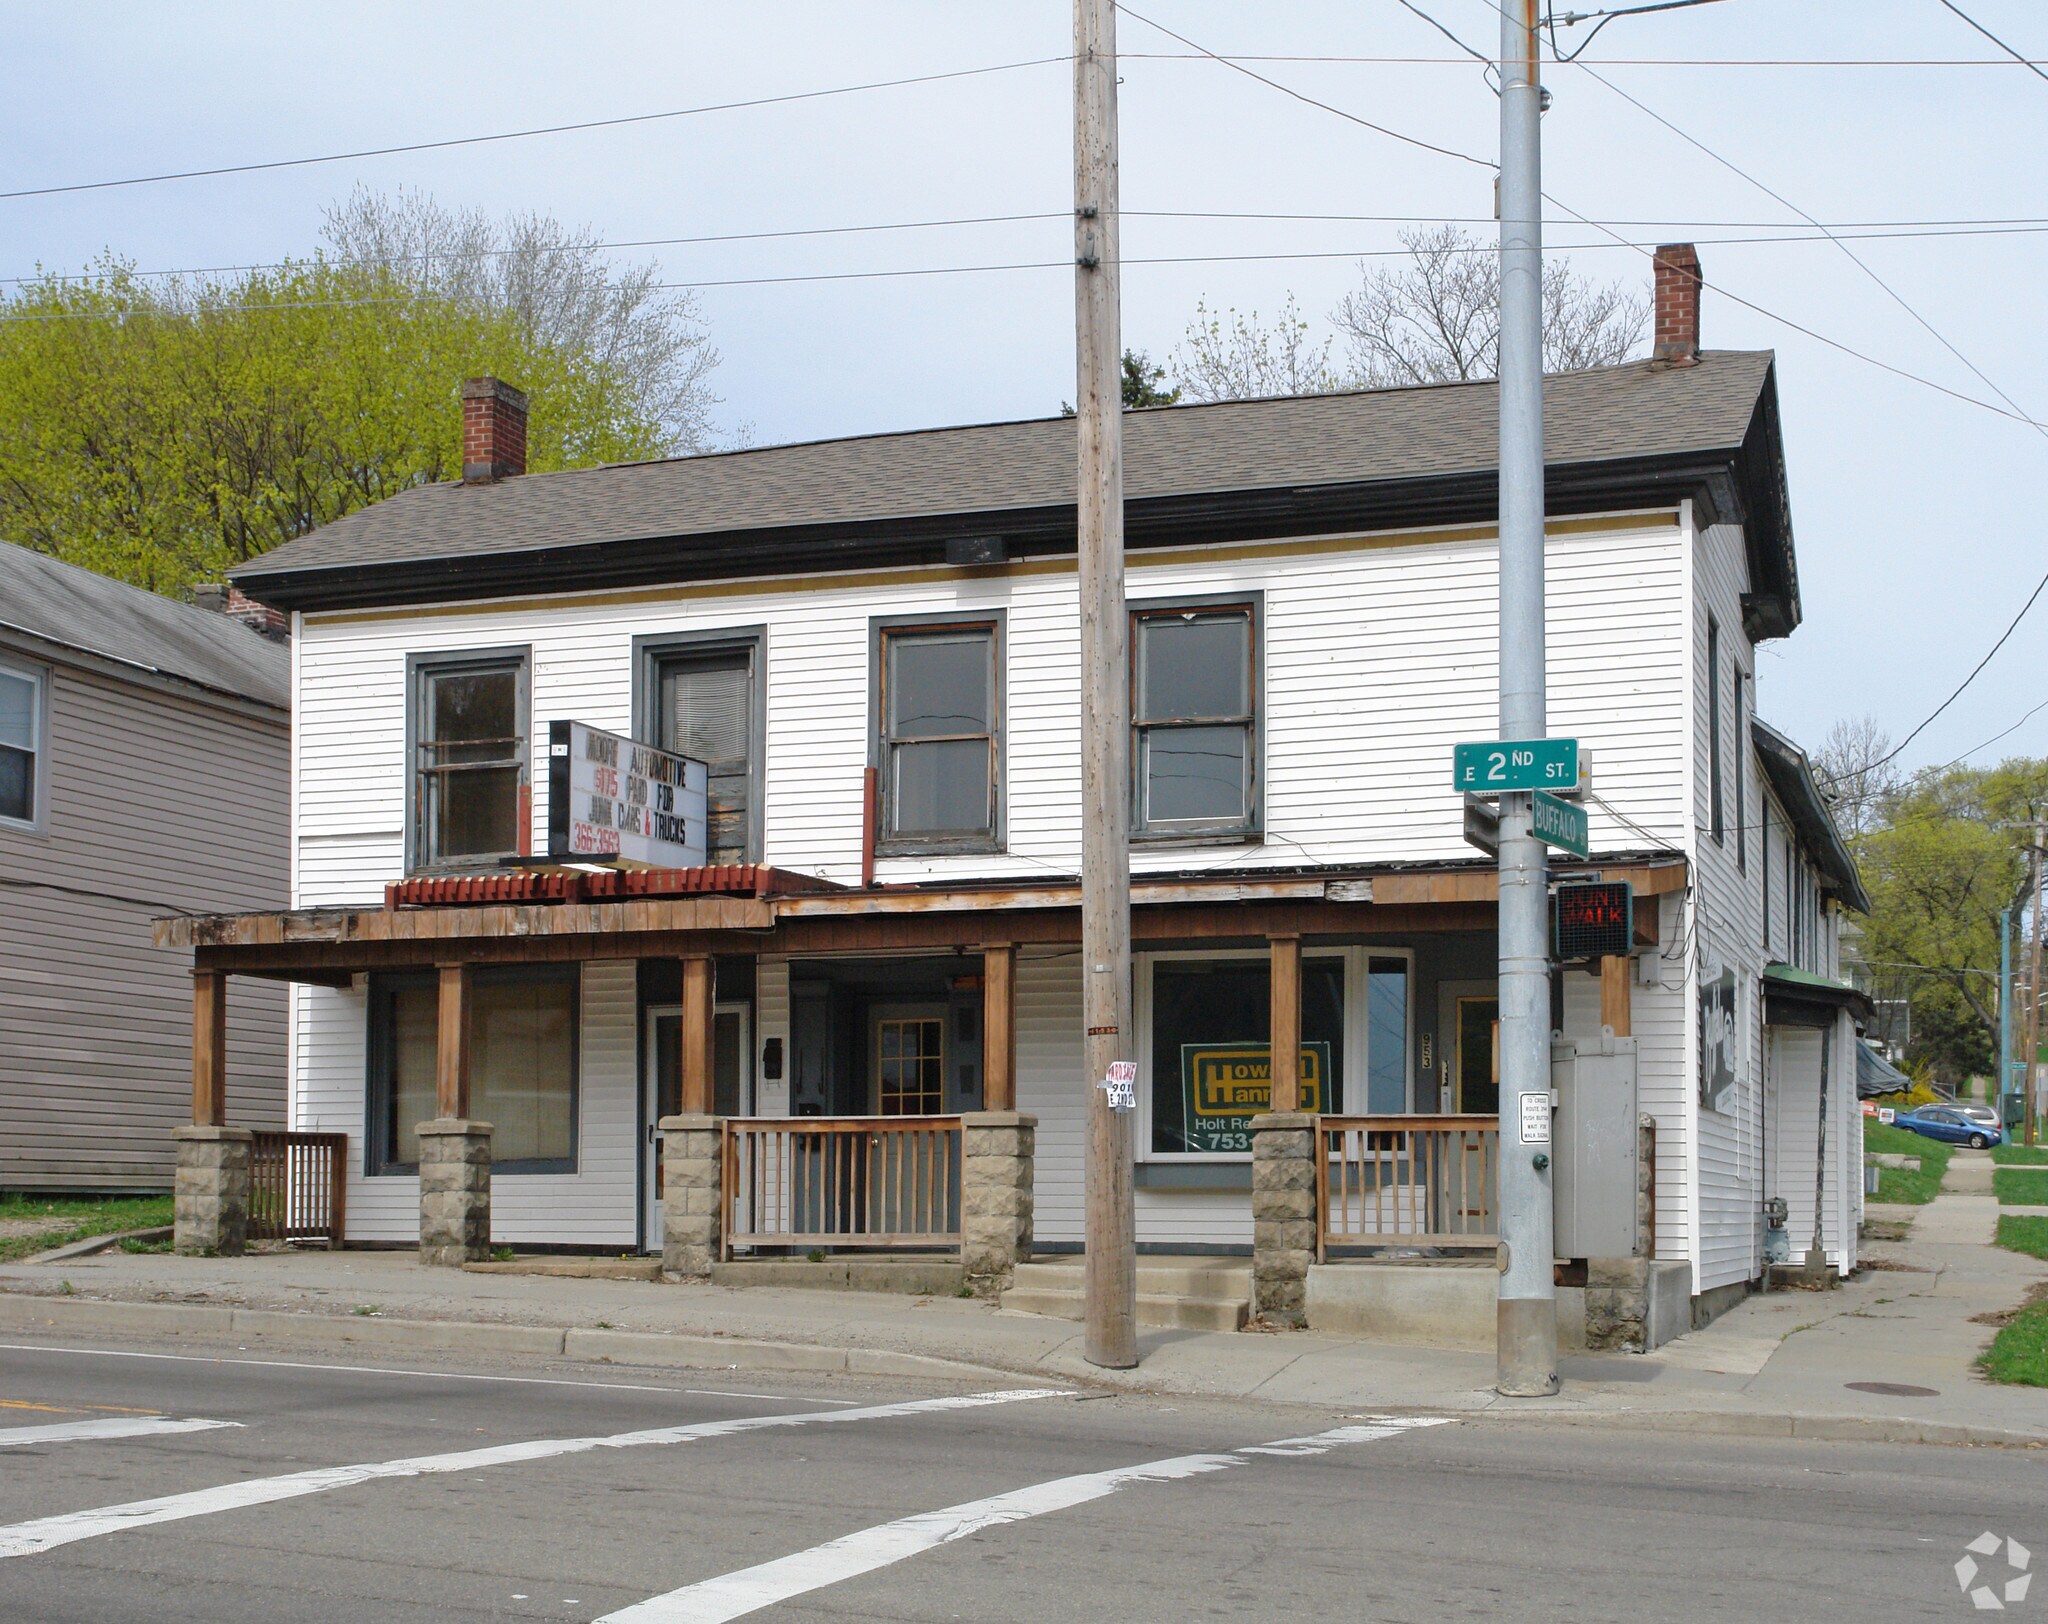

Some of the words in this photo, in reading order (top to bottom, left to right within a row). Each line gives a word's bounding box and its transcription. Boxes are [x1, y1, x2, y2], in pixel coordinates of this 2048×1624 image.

[586, 731, 619, 768] MOORE
[630, 747, 687, 788] AUTOMOTIVE
[1465, 767, 1475, 781] E
[595, 767, 618, 797] $175
[626, 775, 648, 805] PAID
[657, 783, 674, 812] FOR
[588, 795, 613, 826] JUNK
[618, 803, 641, 833] CARS
[645, 809, 651, 836] &
[654, 812, 686, 845] TRUCKS
[1535, 800, 1576, 842] BUFFALO
[1564, 906, 1622, 926] WALK
[1108, 1063, 1123, 1081] YARD
[1195, 1117, 1226, 1130] Holt
